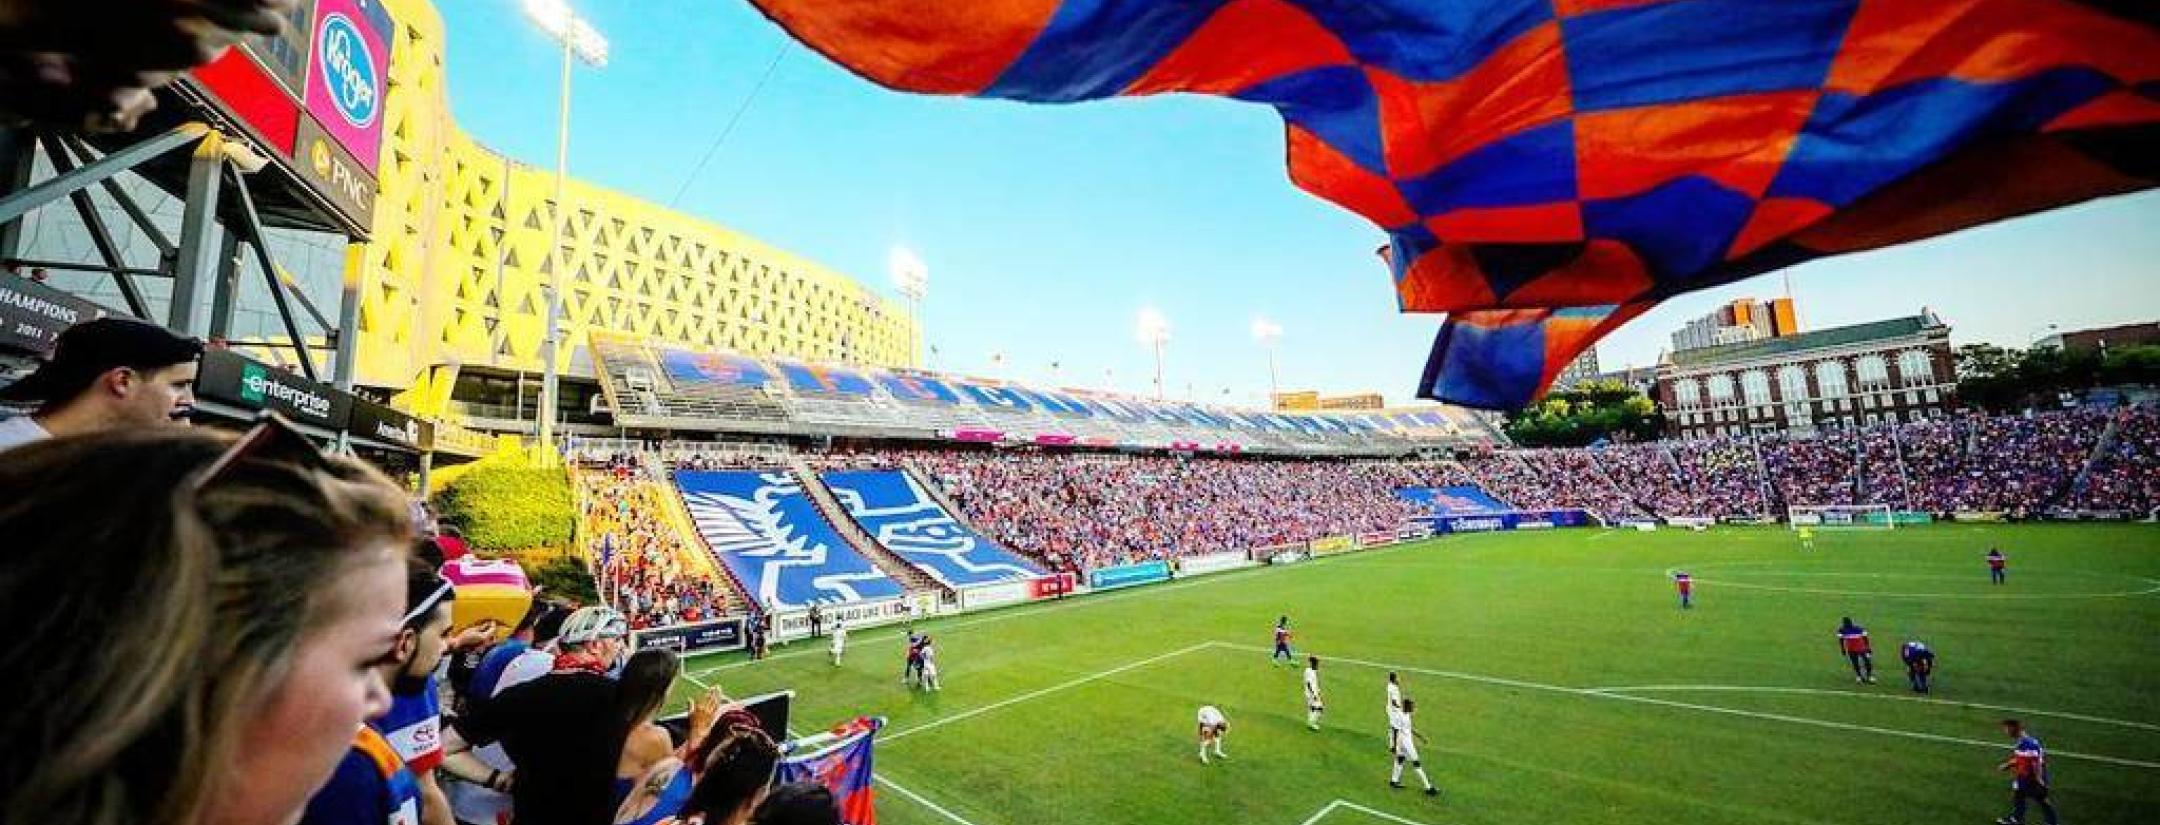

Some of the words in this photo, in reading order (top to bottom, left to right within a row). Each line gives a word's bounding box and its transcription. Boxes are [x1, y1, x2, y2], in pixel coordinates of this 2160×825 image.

[327, 28, 373, 109] Kroger
[332, 158, 368, 210] PNC
[0, 287, 78, 323] HAMPIONS
[247, 375, 330, 410] enterprise
